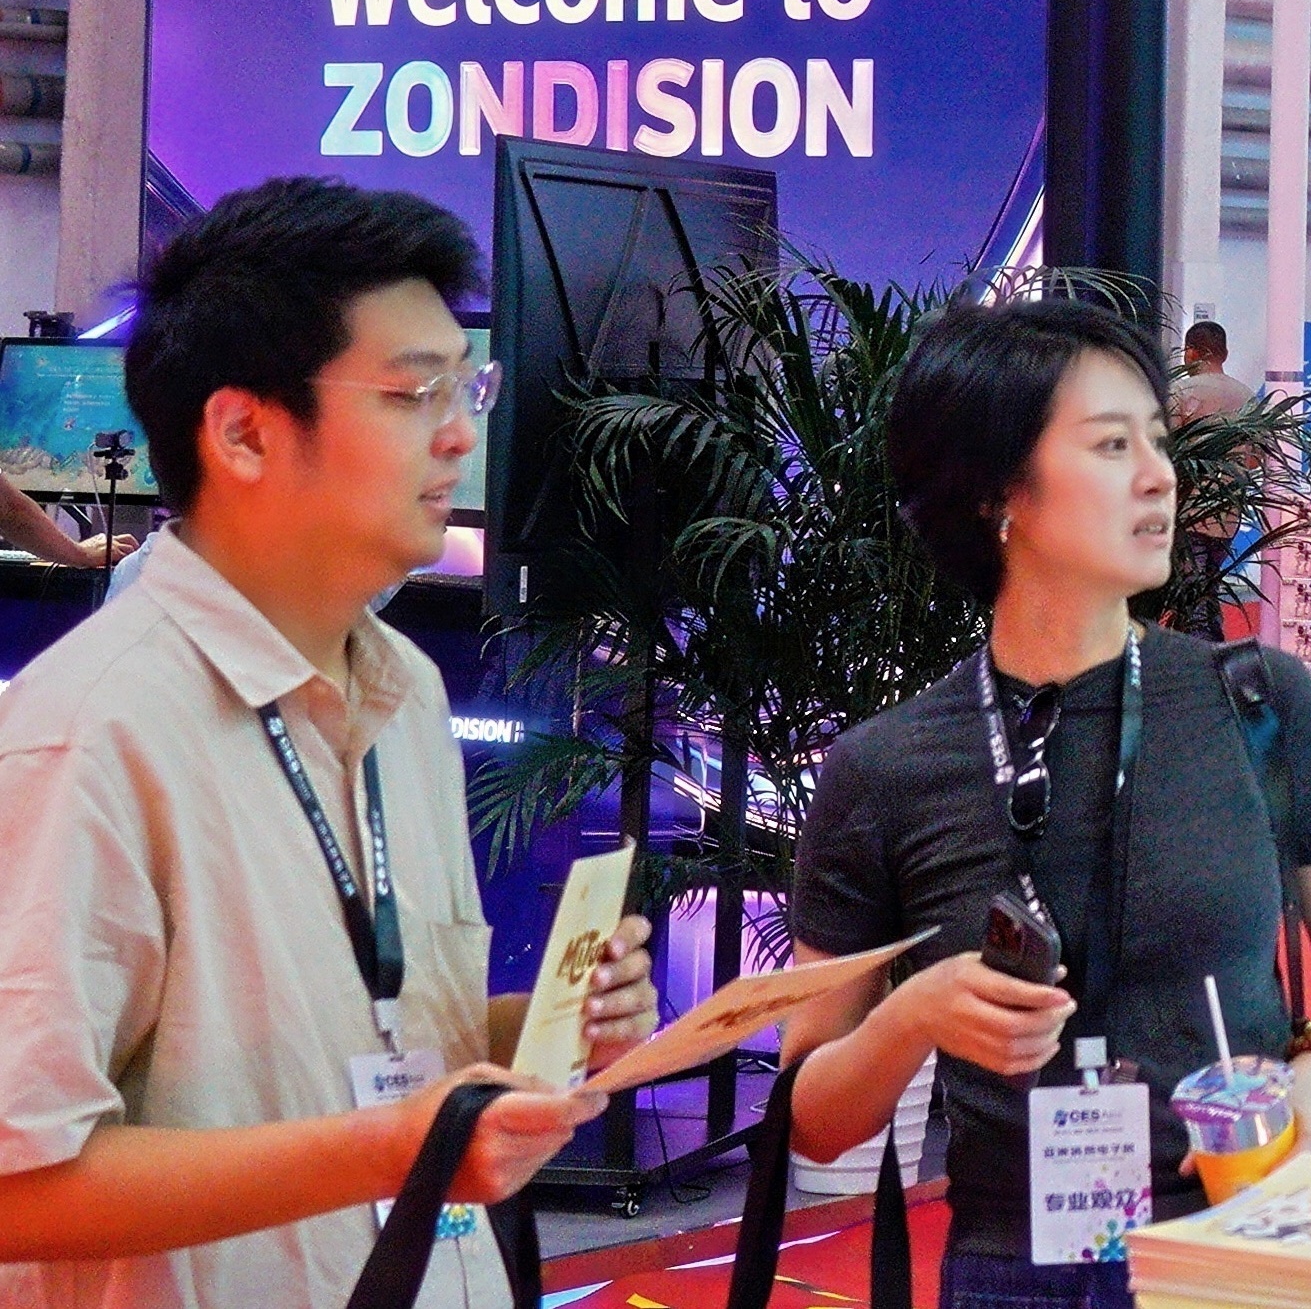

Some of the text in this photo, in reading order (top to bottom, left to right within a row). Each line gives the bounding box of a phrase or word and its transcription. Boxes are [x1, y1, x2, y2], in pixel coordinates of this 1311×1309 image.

[320, 58, 875, 158] ZONDISION
[448, 716, 513, 744] DISION
[1069, 1109, 1101, 1122] CES
[1045, 1187, 1137, 1213] 专业观众
